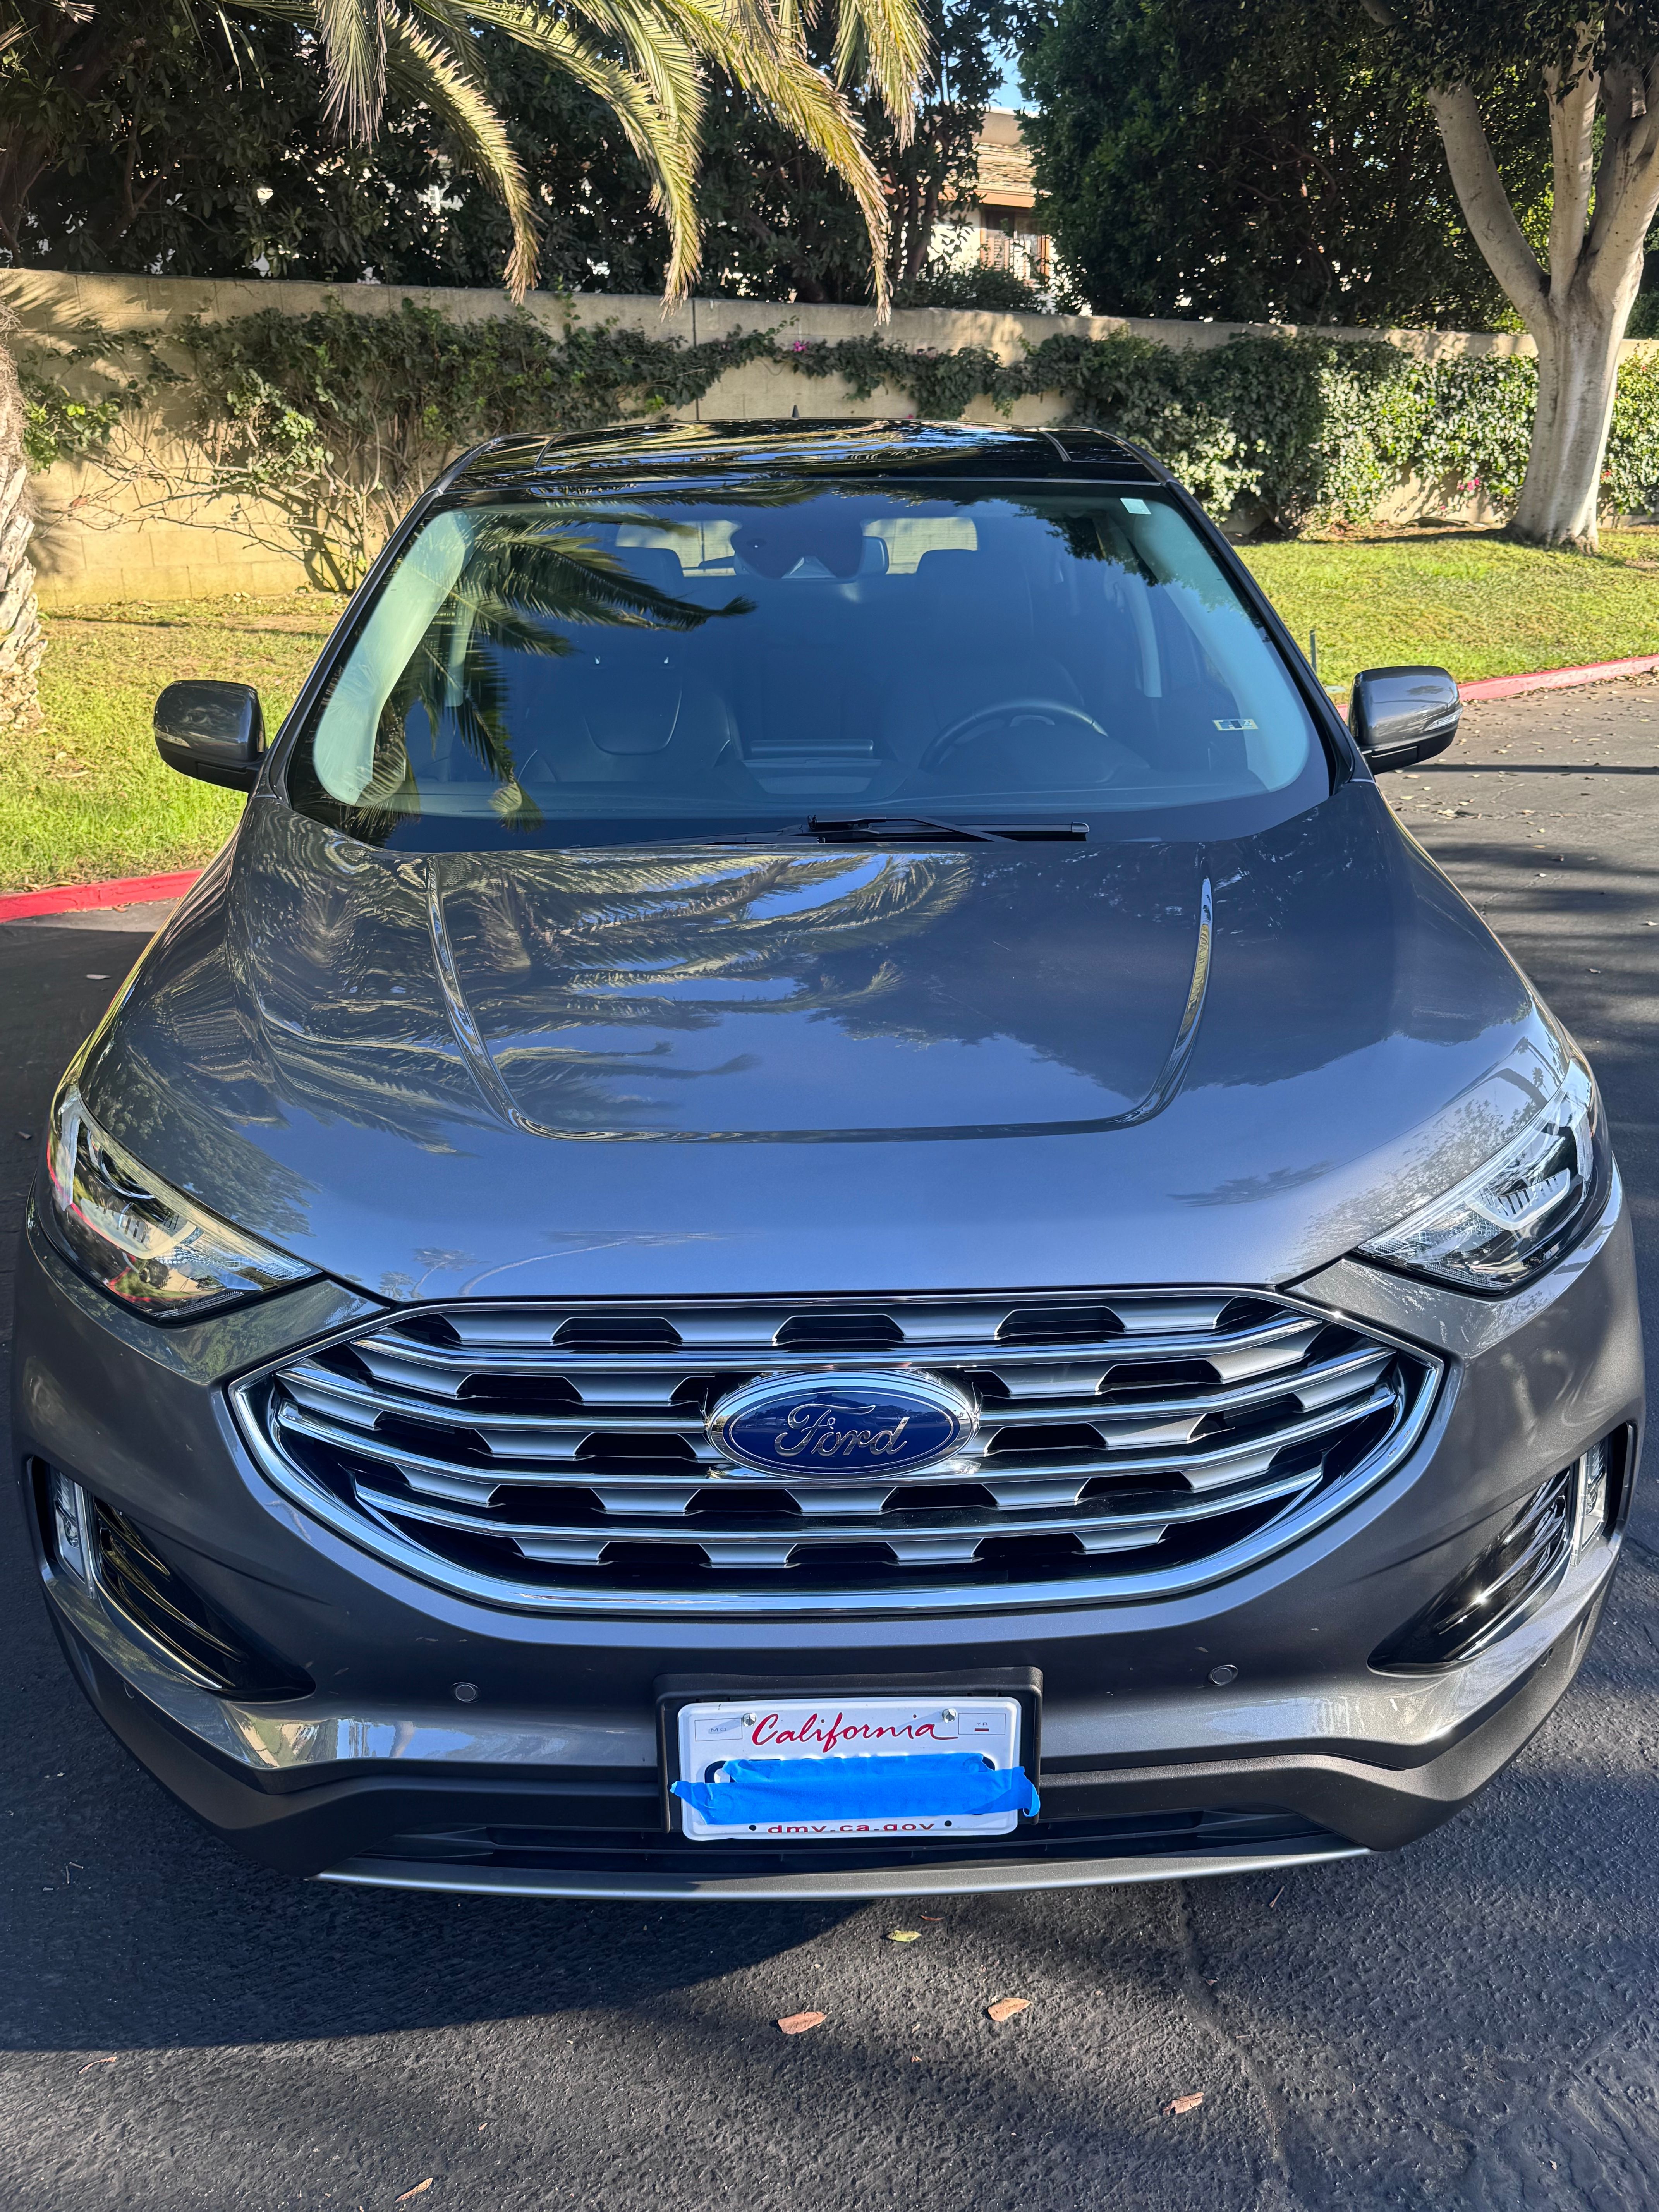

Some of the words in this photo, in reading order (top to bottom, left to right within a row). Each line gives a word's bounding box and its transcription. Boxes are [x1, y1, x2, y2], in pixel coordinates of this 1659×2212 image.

[775, 1403, 909, 1456] Ford
[752, 1712, 958, 1753] California
[768, 1823, 934, 1833] dmv.ca.gov
